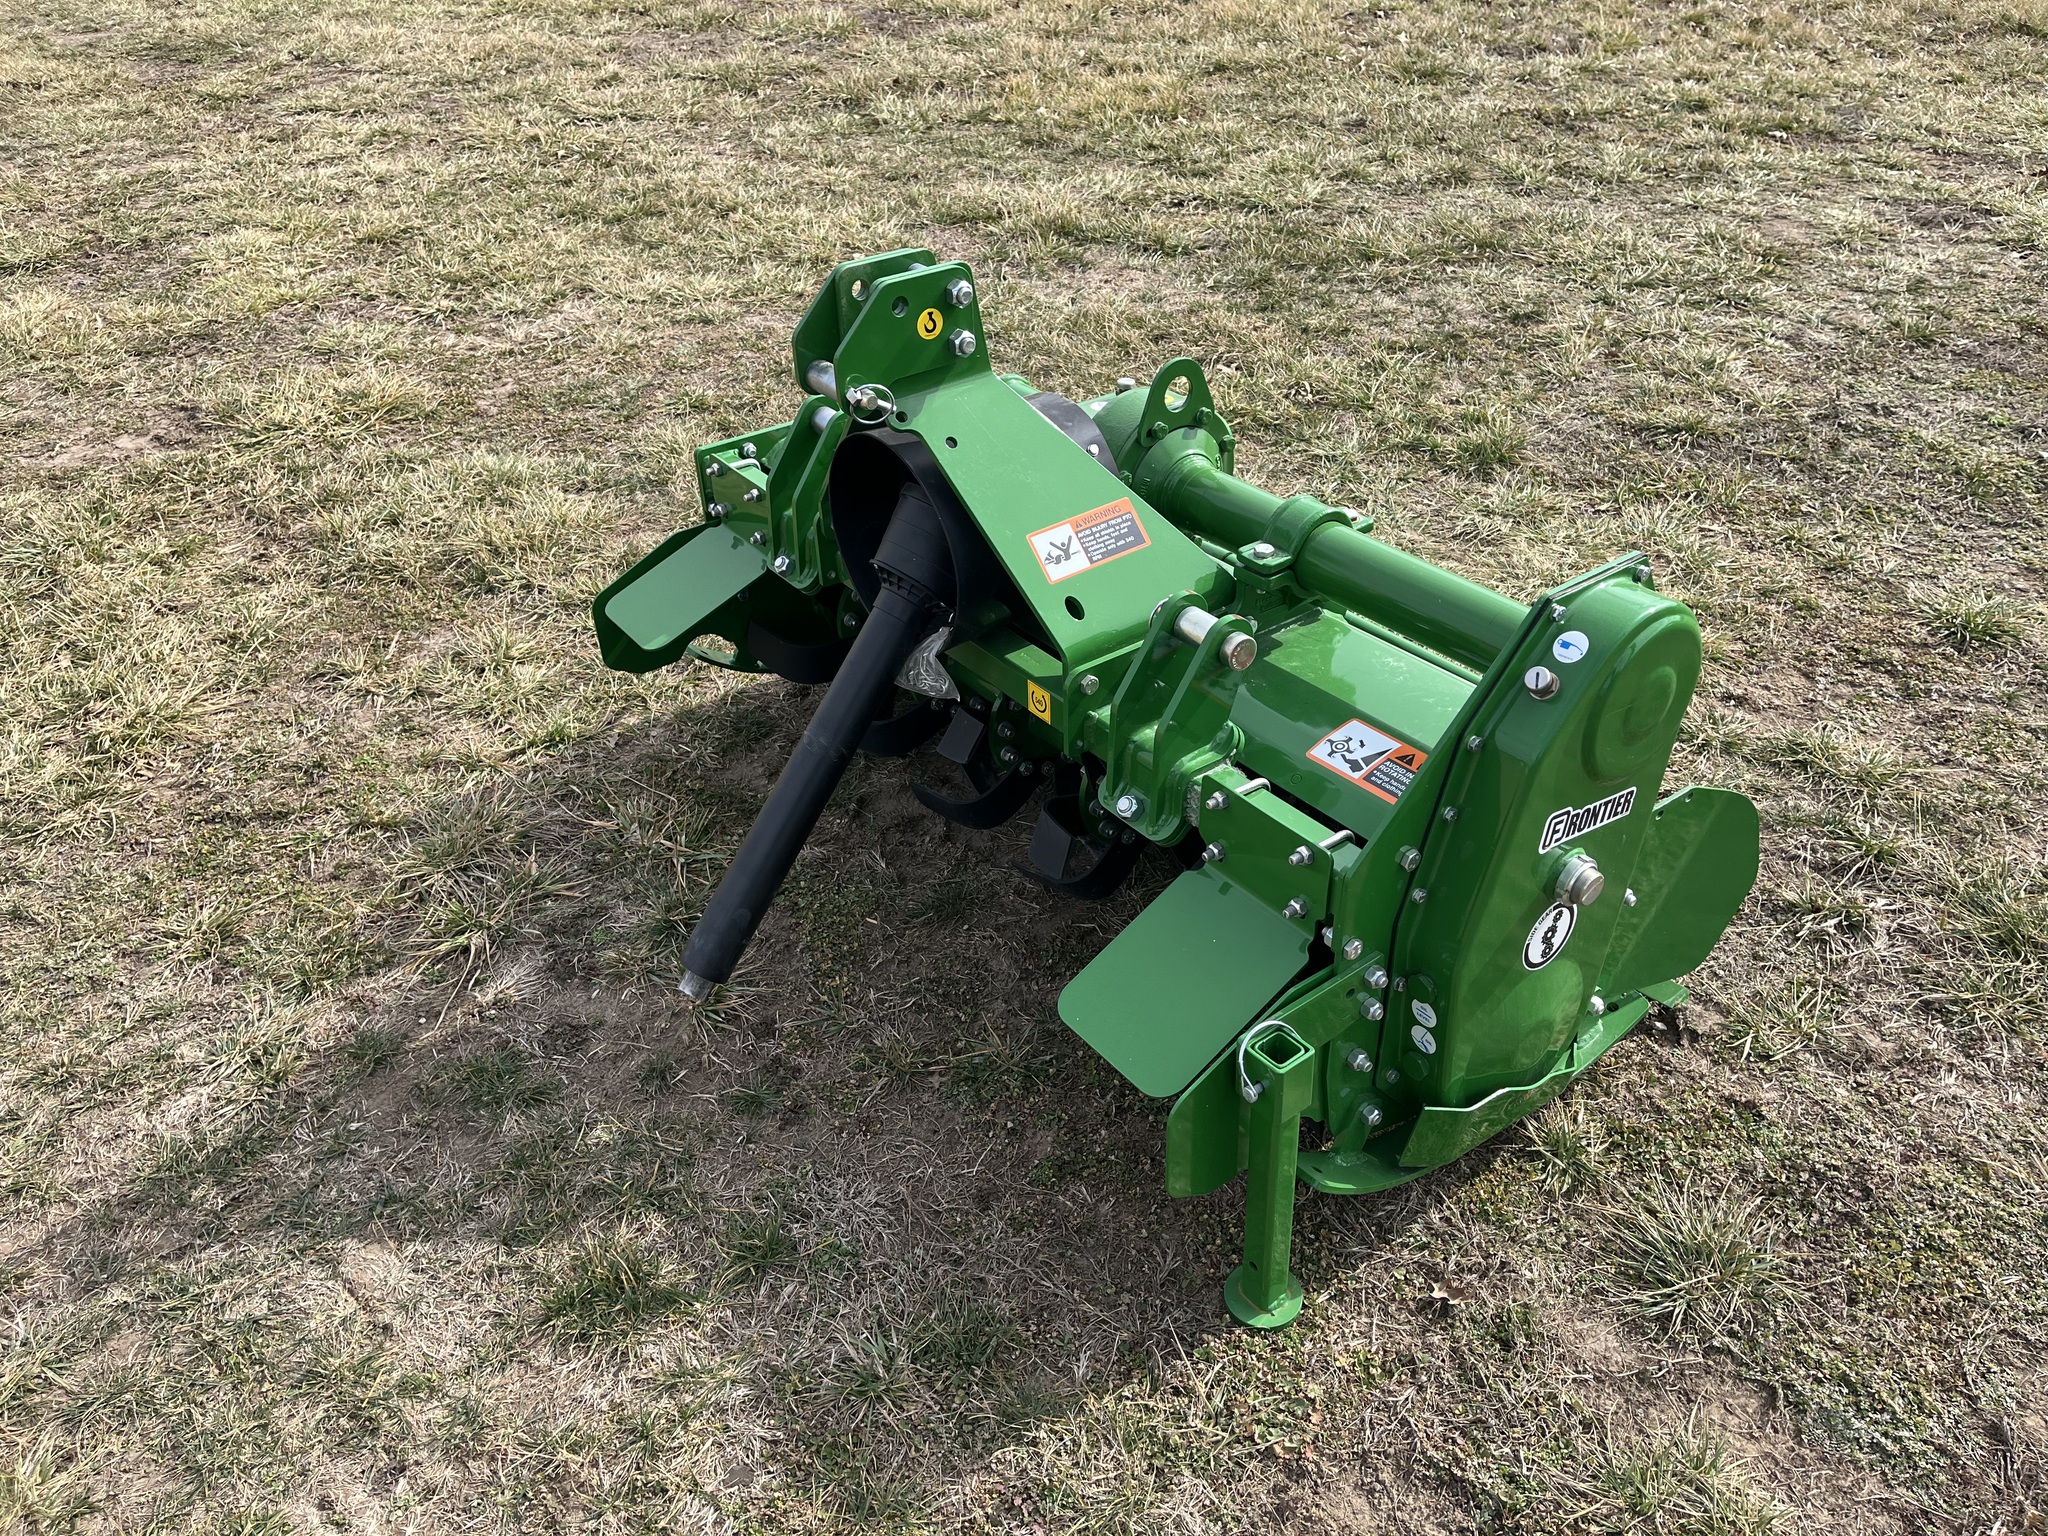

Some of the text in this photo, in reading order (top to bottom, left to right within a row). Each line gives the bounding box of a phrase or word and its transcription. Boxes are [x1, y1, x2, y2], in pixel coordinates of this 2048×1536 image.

[1081, 505, 1121, 525] WARNING
[1092, 523, 1108, 532] INJURY
[1109, 517, 1122, 526] FROM
[1383, 761, 1407, 774] AVOID
[1370, 776, 1383, 784] and
[1542, 789, 1635, 850] FRONTIER
